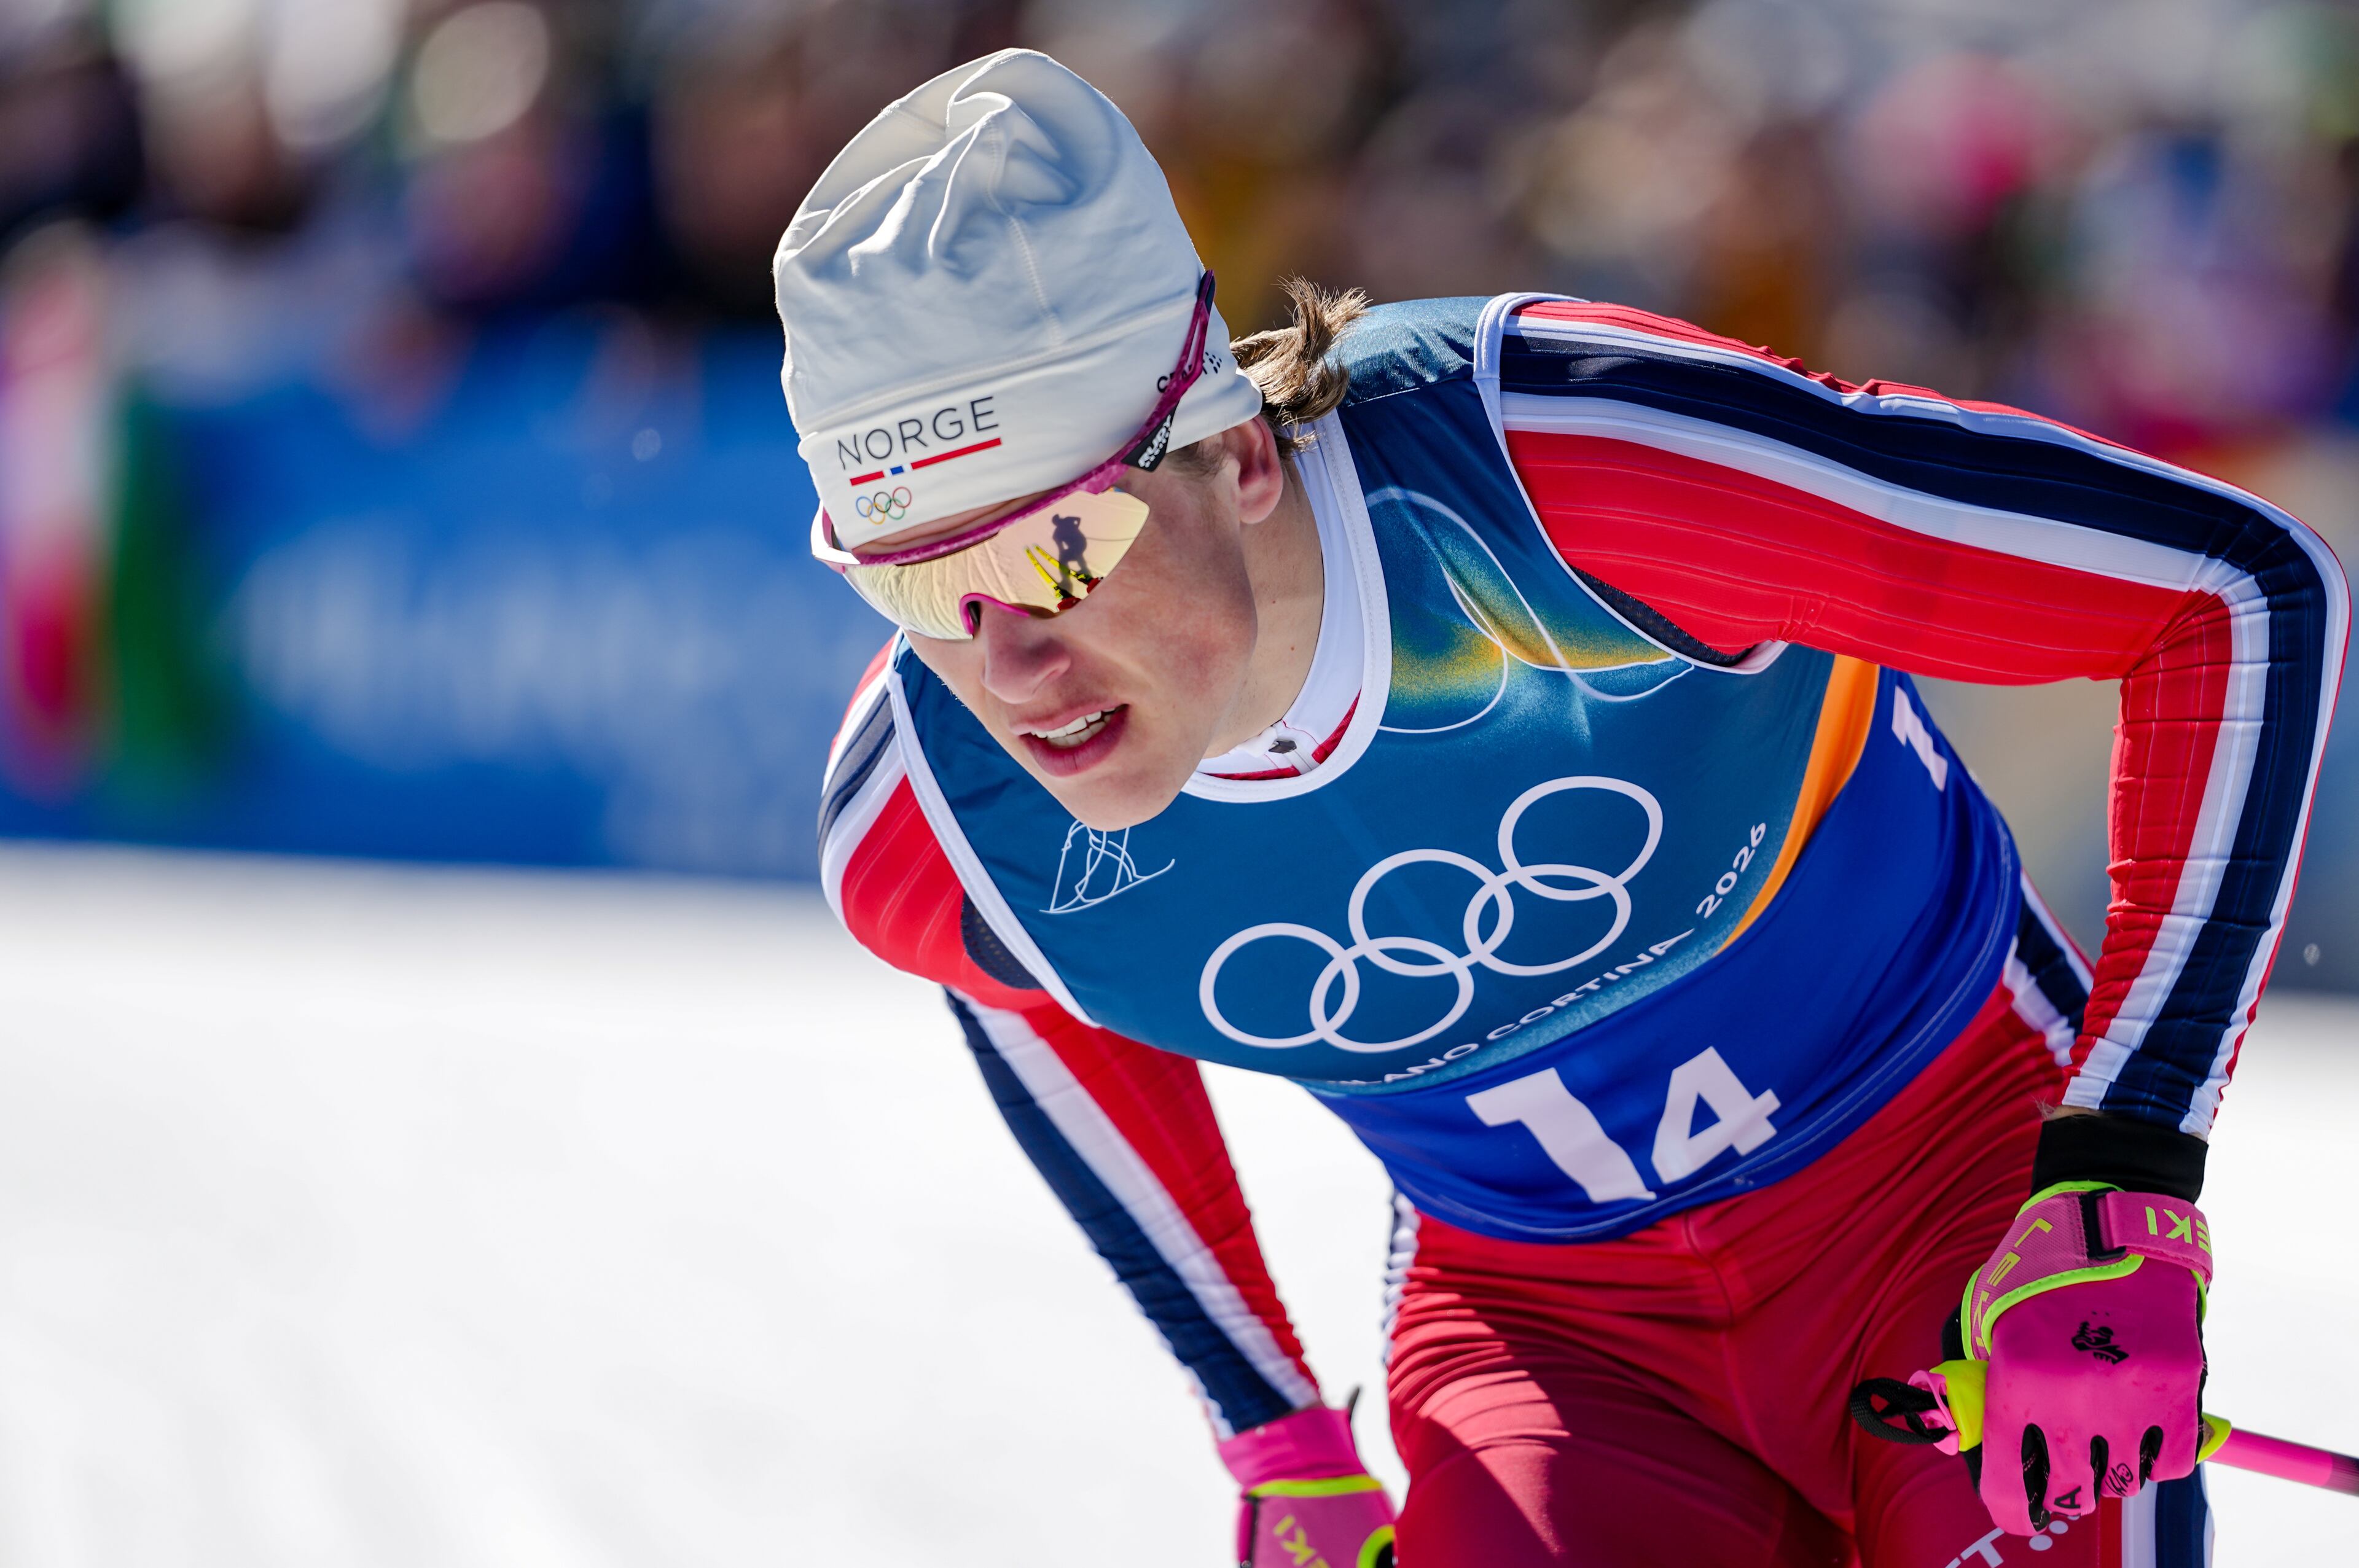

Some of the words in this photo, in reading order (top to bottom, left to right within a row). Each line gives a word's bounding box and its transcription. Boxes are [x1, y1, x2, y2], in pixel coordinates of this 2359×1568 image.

[837, 396, 999, 470] NORGE
[1487, 928, 1696, 1040] CORTINA
[1696, 822, 1767, 919] 2026
[1465, 1046, 1782, 1203] 14
[1973, 1217, 2053, 1348] LEKI
